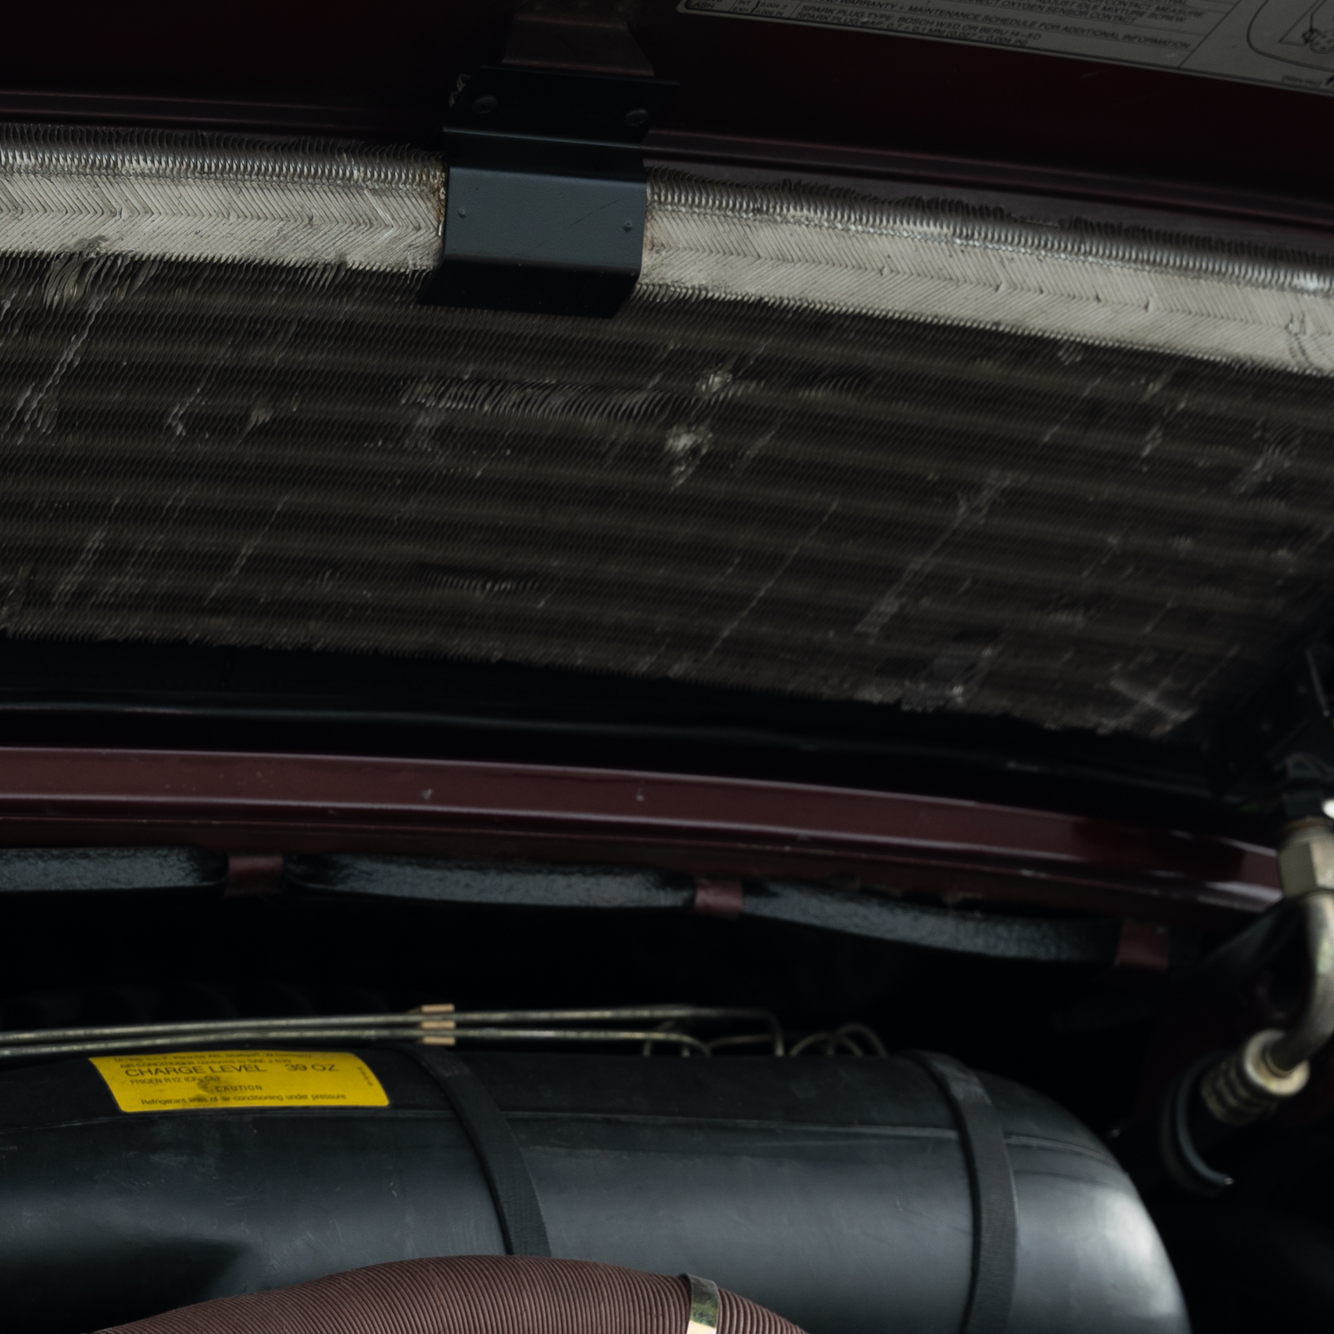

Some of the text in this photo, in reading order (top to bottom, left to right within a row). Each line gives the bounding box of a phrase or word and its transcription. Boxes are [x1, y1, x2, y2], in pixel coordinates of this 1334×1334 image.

[124, 1065, 207, 1077] CHARGE
[209, 1063, 268, 1074] LEVEL
[310, 1063, 340, 1073] OZ
[215, 1084, 264, 1093] CAUTION
